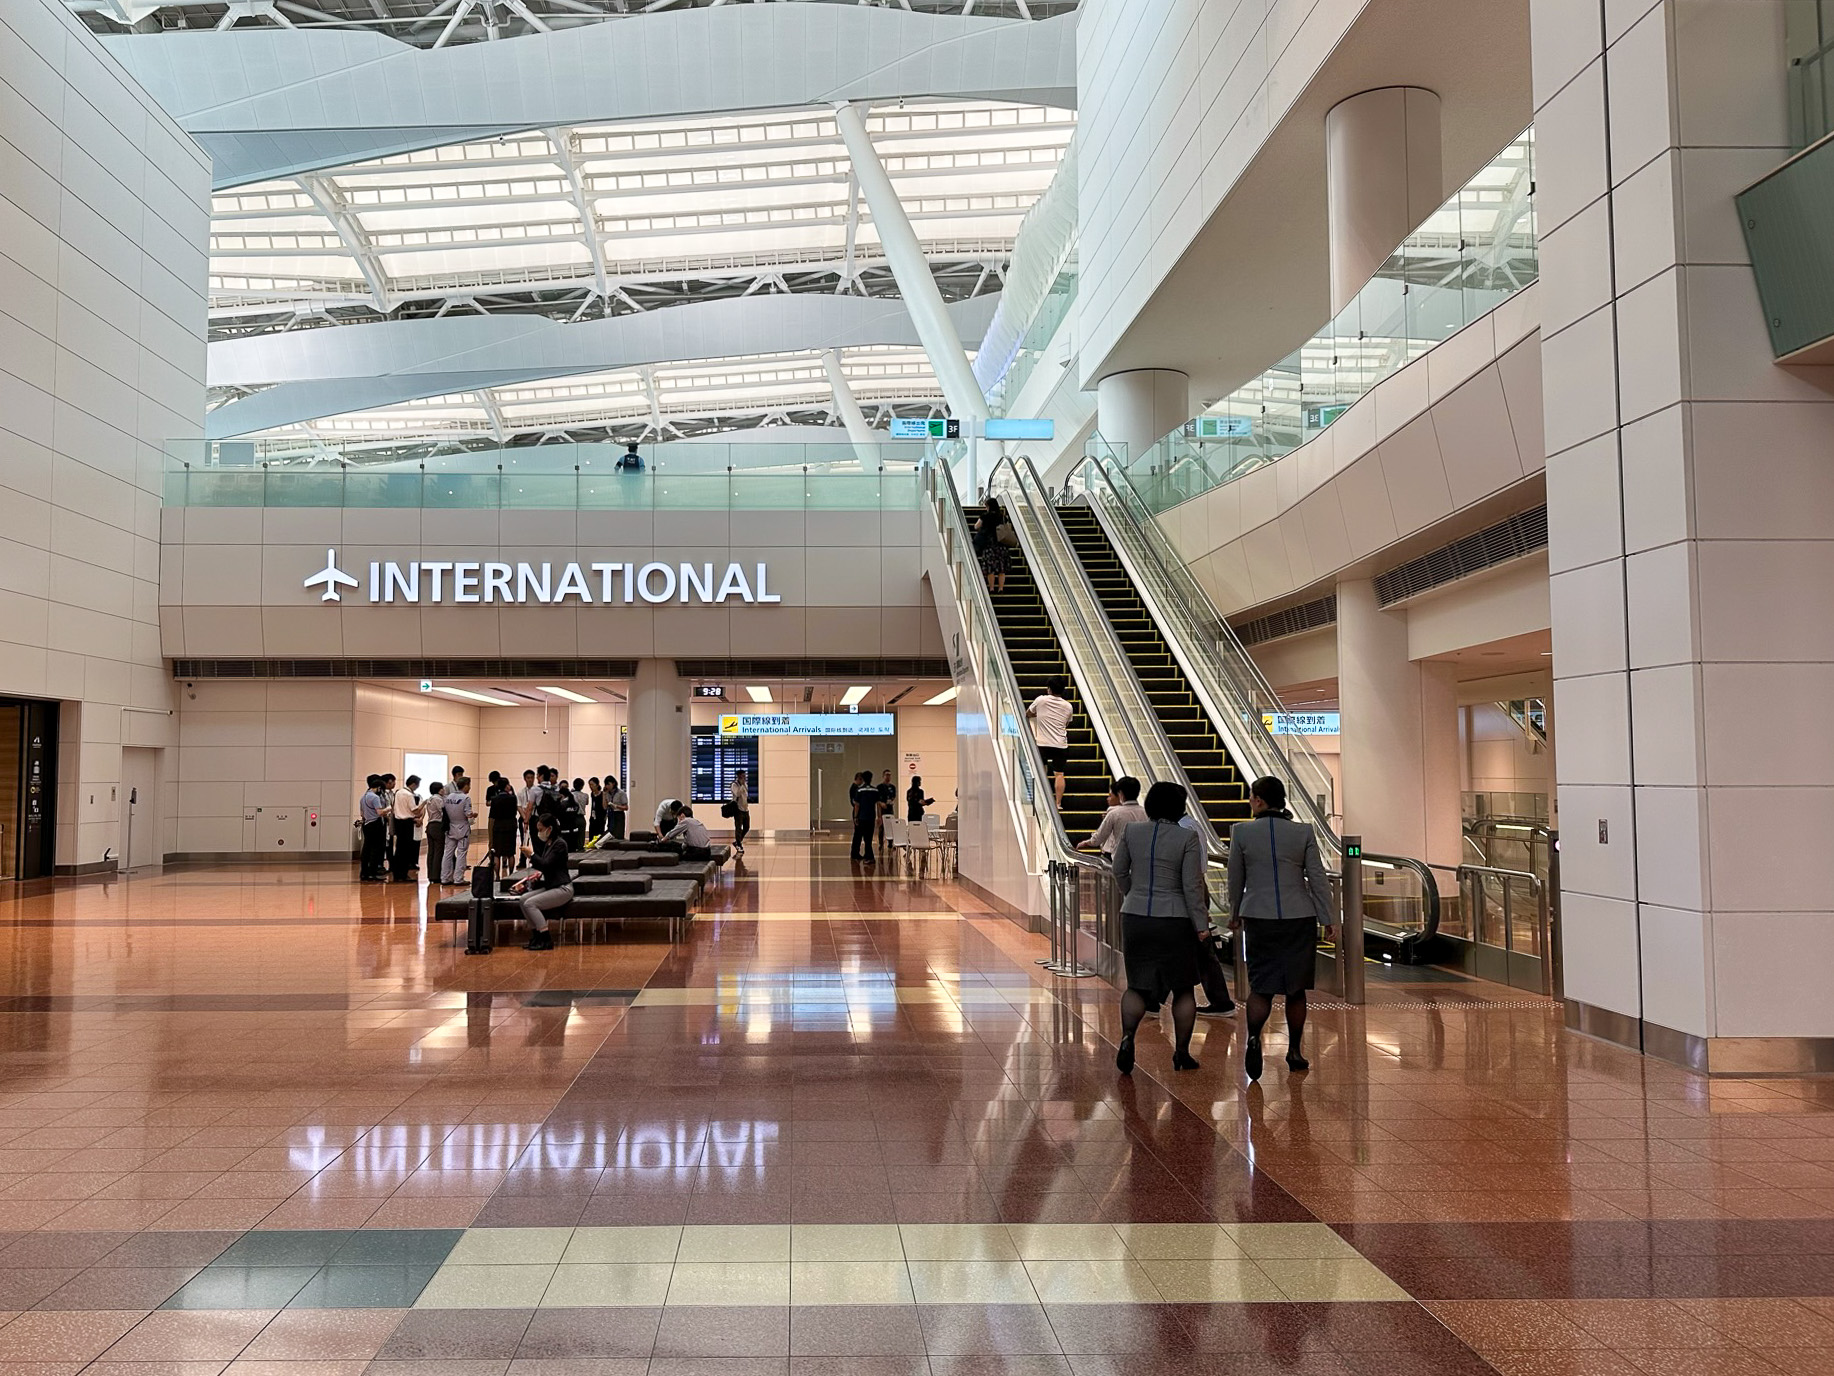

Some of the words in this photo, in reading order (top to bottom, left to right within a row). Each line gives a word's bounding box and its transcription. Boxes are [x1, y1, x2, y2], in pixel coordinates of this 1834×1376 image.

[948, 425, 958, 433] 3F
[369, 561, 782, 604] INTERNATIONAL
[702, 687, 722, 696] 9:28
[742, 716, 790, 726] 国際線到着
